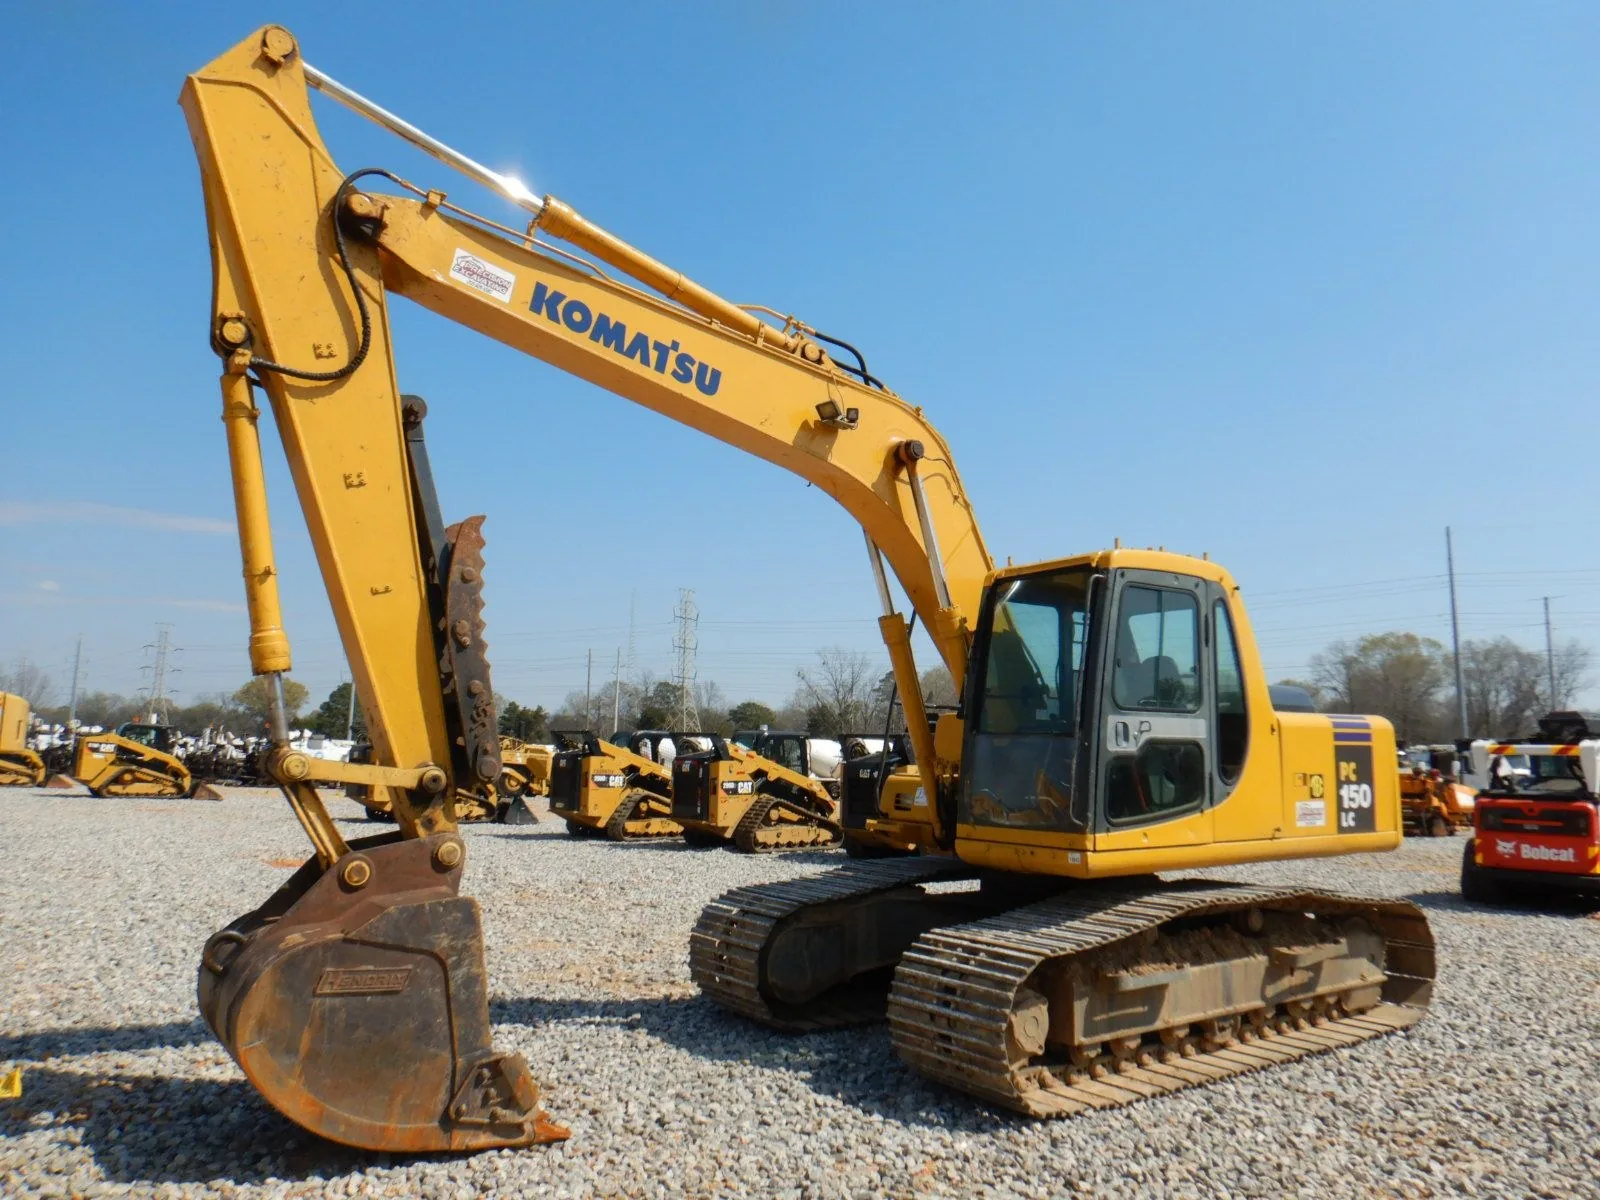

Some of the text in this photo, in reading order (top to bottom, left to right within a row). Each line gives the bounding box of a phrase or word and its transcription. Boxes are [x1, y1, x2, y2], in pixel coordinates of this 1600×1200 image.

[529, 281, 722, 396] KOMATSU
[609, 775, 624, 787] CAT
[1339, 761, 1357, 782] PC
[738, 781, 752, 794] CAT
[1339, 783, 1372, 809] 150
[1340, 811, 1355, 828] LC
[1521, 843, 1575, 863] Bobcat
